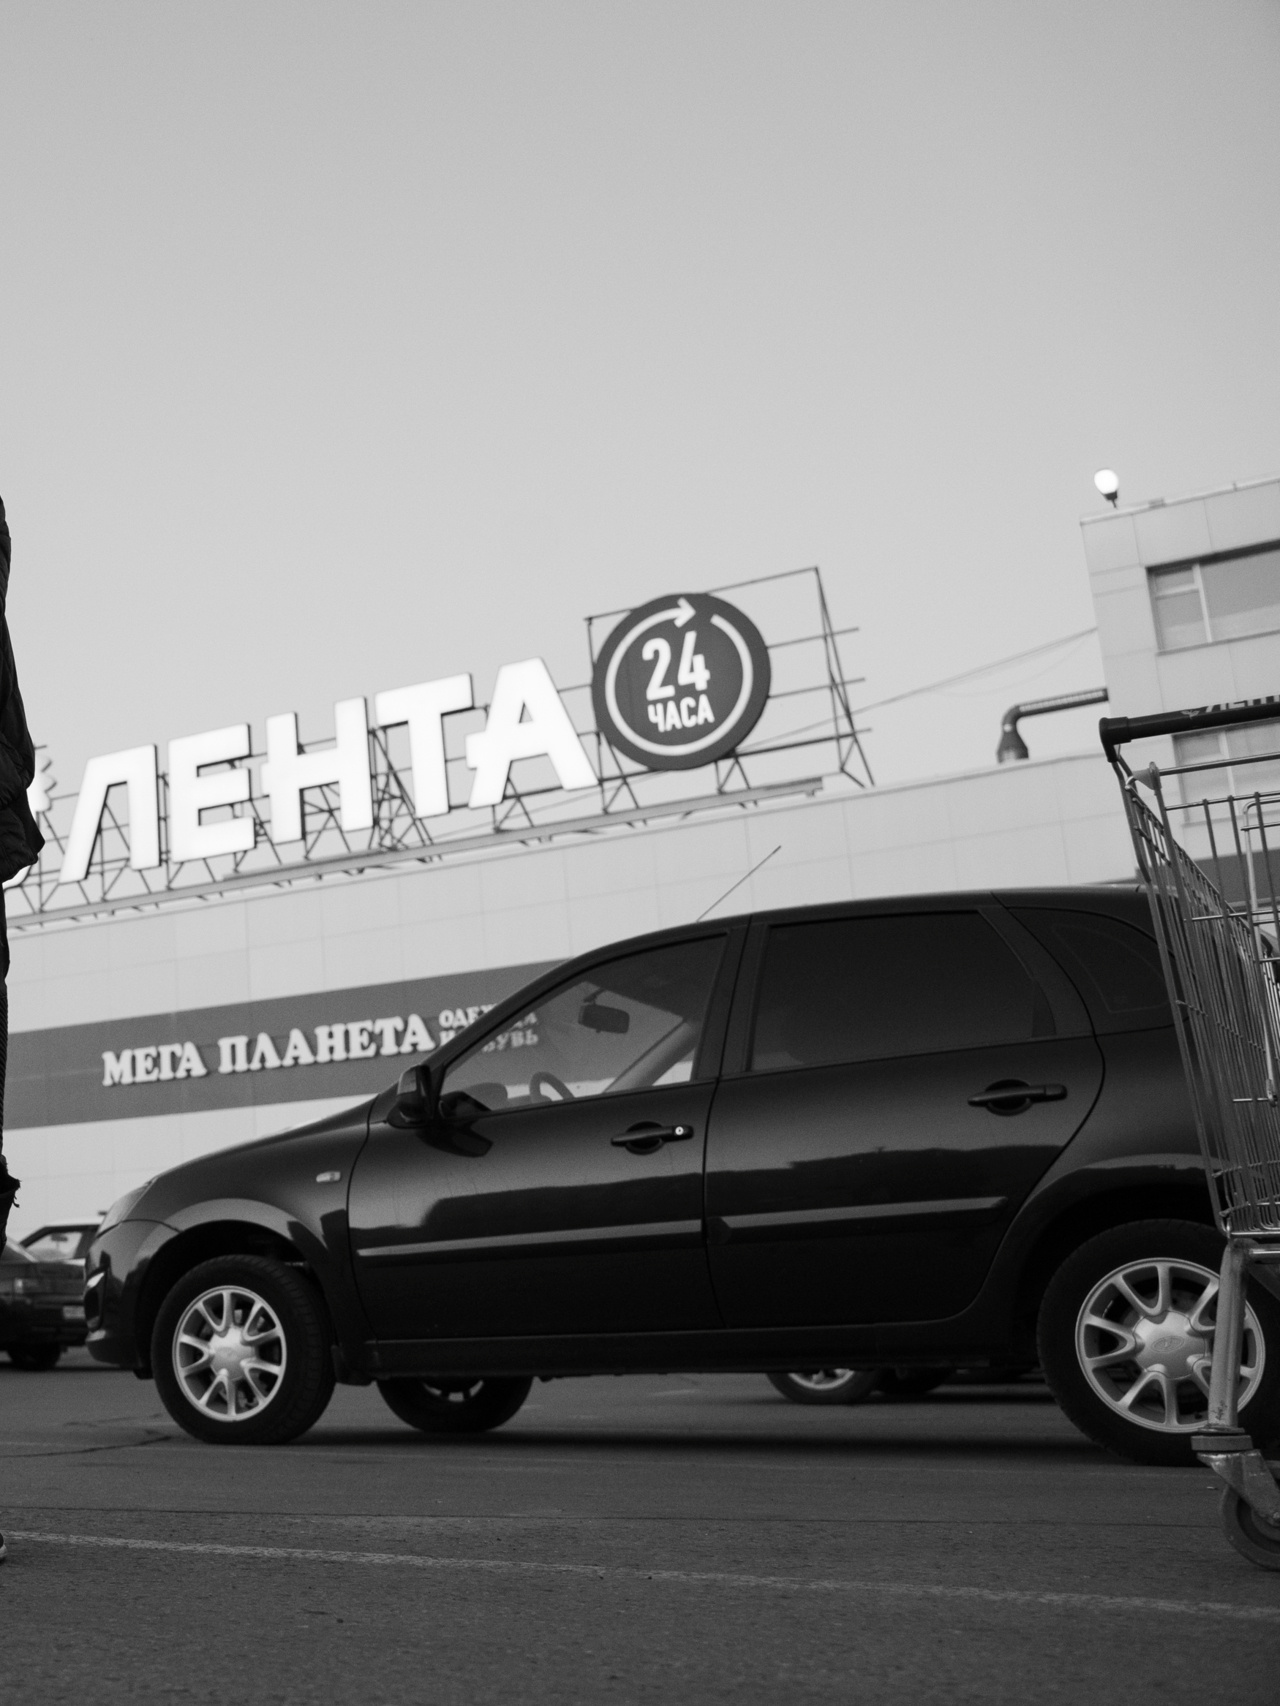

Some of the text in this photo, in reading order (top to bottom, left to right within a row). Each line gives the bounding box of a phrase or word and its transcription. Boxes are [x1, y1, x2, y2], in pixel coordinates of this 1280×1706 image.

[641, 630, 711, 701] 24
[647, 693, 715, 733] ЧАСА
[58, 656, 599, 884] ЛЕНТА
[101, 1013, 437, 1087] МЕГА ПЛАНЕТА
